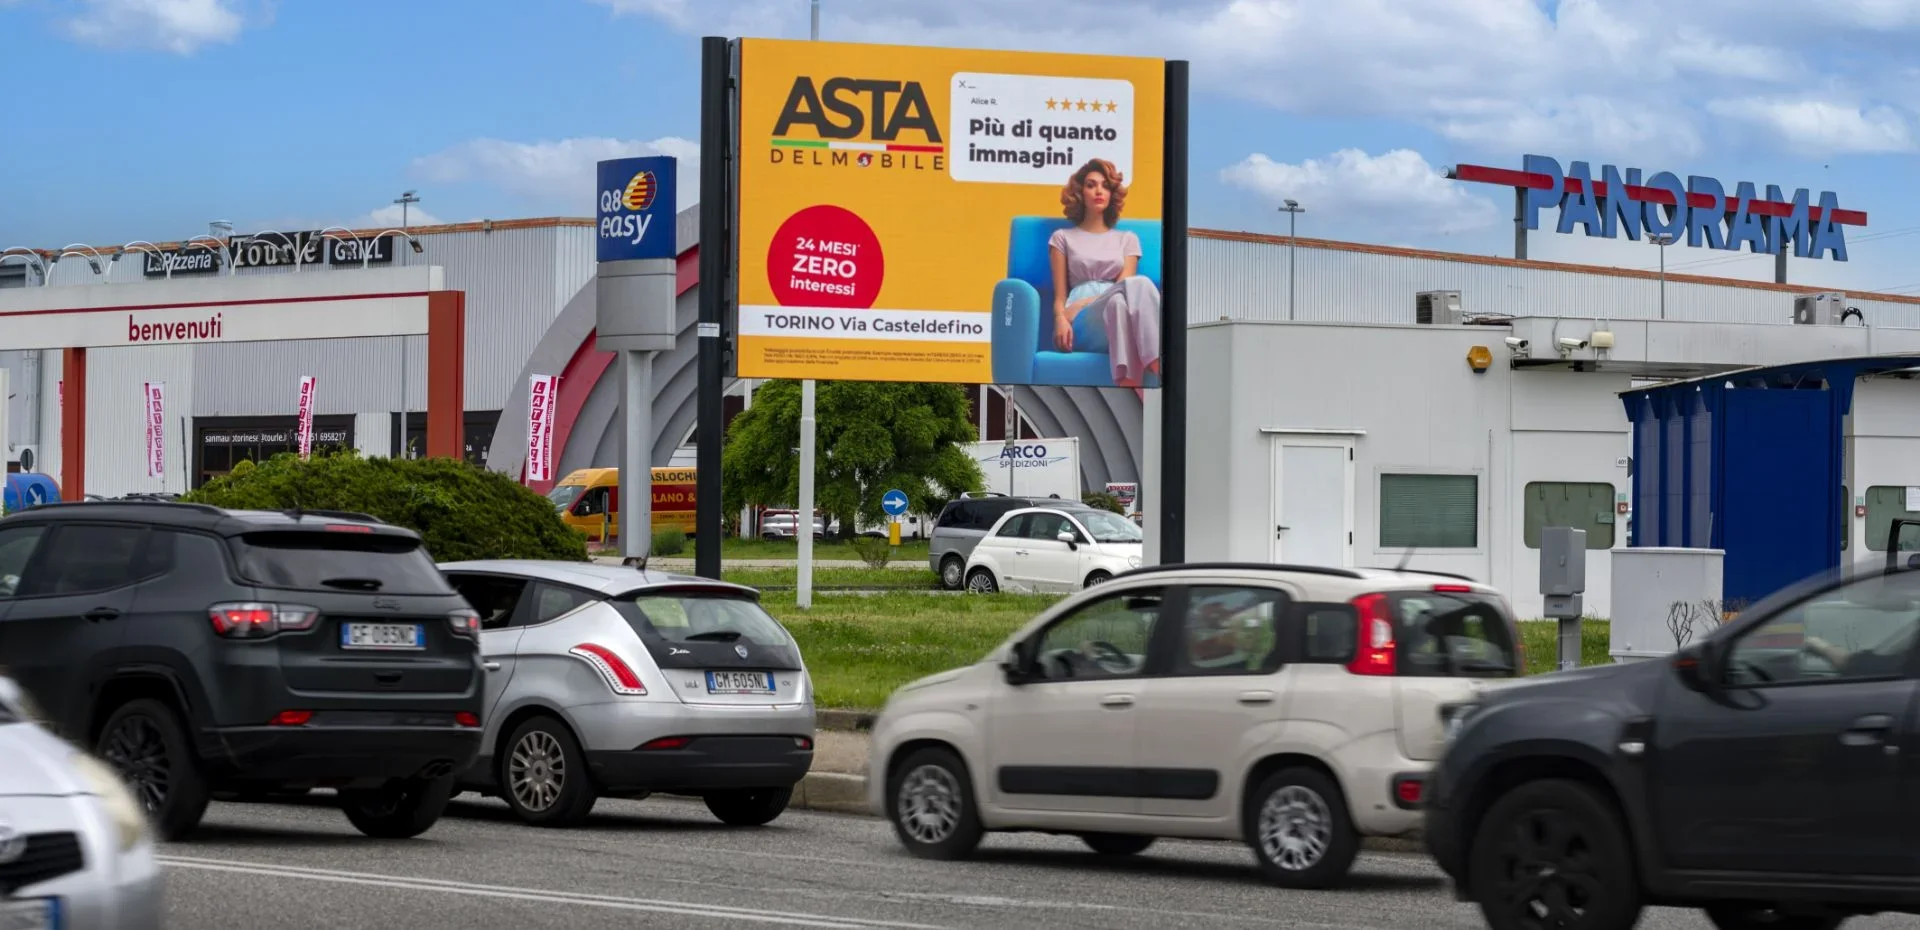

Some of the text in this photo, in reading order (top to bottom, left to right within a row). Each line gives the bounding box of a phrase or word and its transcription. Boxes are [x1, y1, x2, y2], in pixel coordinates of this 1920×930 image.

[772, 76, 942, 143] ASTA
[971, 97, 998, 106] Alice R.
[969, 117, 1117, 142] Più di quanto
[969, 143, 1073, 169] immagini
[600, 189, 622, 213] Q8
[1523, 154, 1848, 262] PANORAMA
[600, 213, 653, 245] easy
[796, 237, 815, 251] 24
[792, 254, 857, 279] ZERO
[790, 276, 856, 296] interessi
[128, 312, 222, 342] benvenuti
[765, 314, 983, 335] TORINO Via Casteldefino
[320, 432, 346, 442] 6958217
[1000, 444, 1047, 459] ARCO
[1000, 459, 1048, 469] SPEDIZIONI
[652, 492, 684, 503] LANO
[733, 672, 768, 689] 605NL
